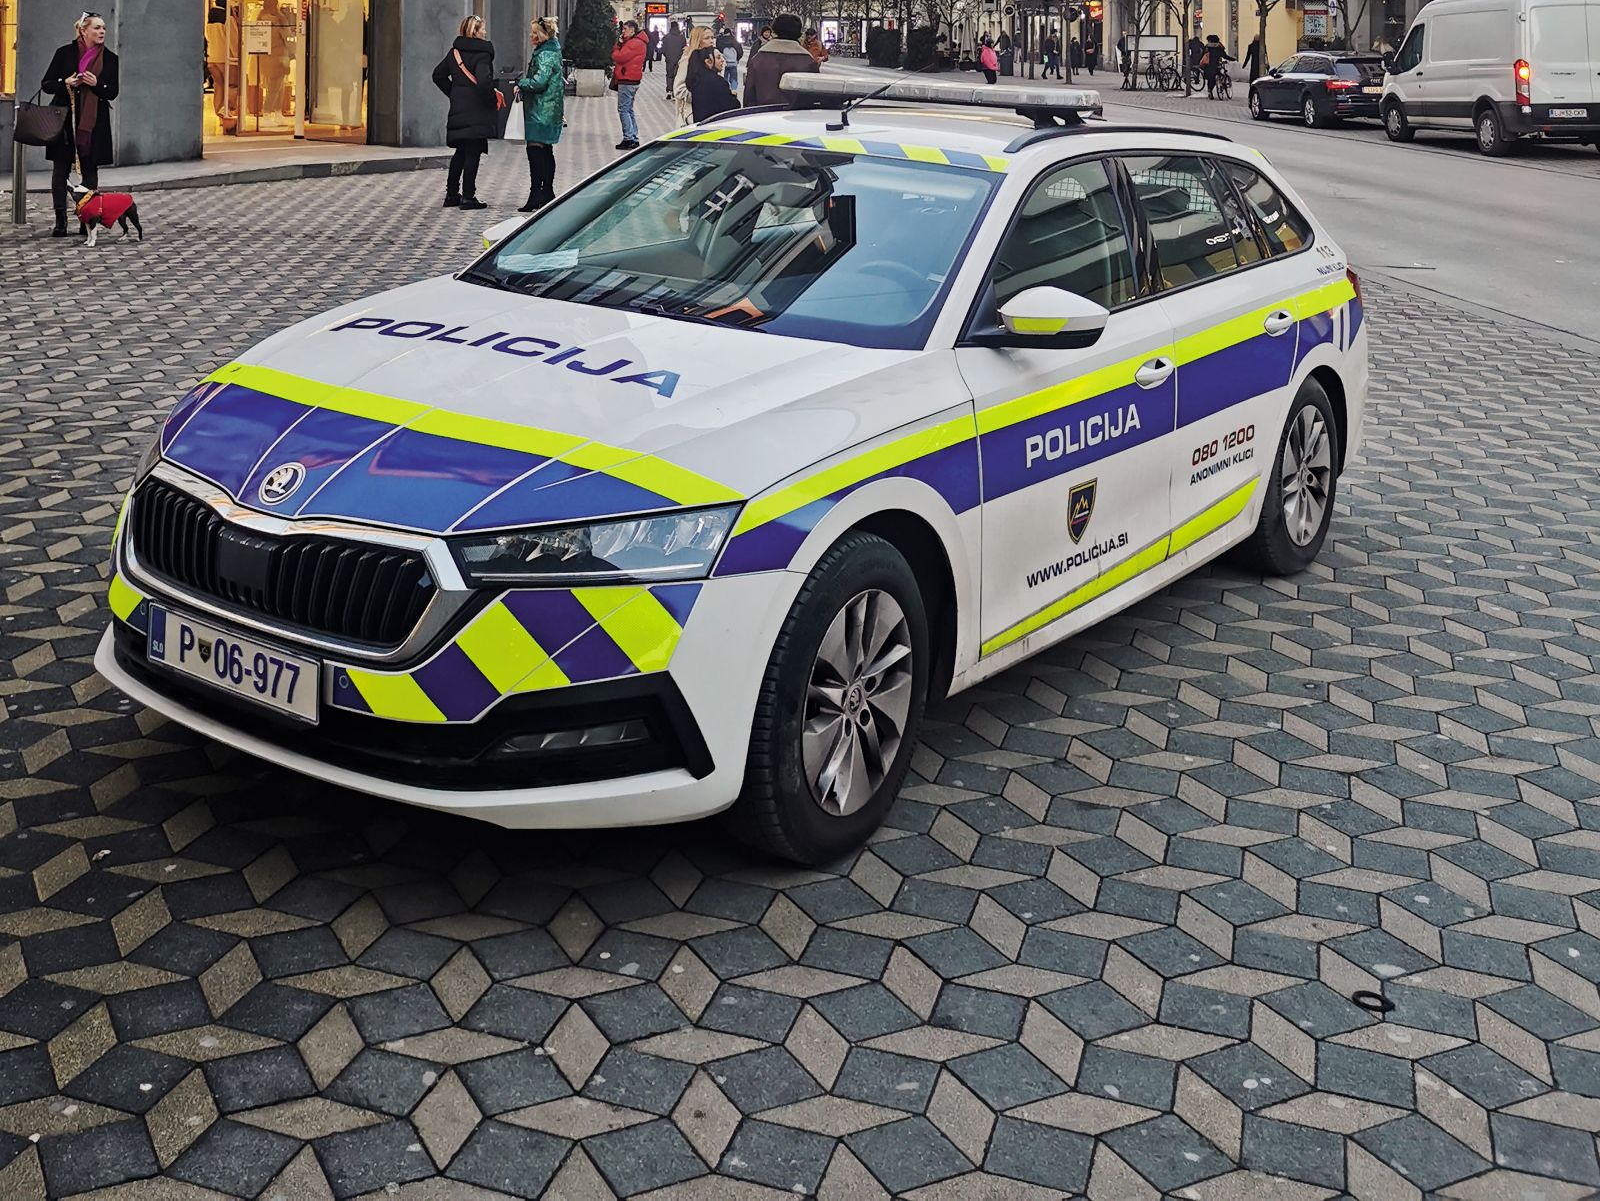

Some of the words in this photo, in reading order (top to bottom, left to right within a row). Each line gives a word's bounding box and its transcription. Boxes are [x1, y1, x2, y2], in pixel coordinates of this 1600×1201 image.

[1316, 245, 1335, 259] 113
[330, 317, 681, 398] POLICIJA
[1025, 403, 1141, 469] POLICIJA
[1191, 439, 1219, 467] 080
[1222, 424, 1255, 452] 1200
[1189, 459, 1231, 486] ANONIMNI
[1232, 447, 1254, 466] KLICI
[1026, 531, 1129, 589] WWW.POLICIJA.SI
[152, 639, 164, 654] SLO
[213, 637, 300, 704] 06-977
